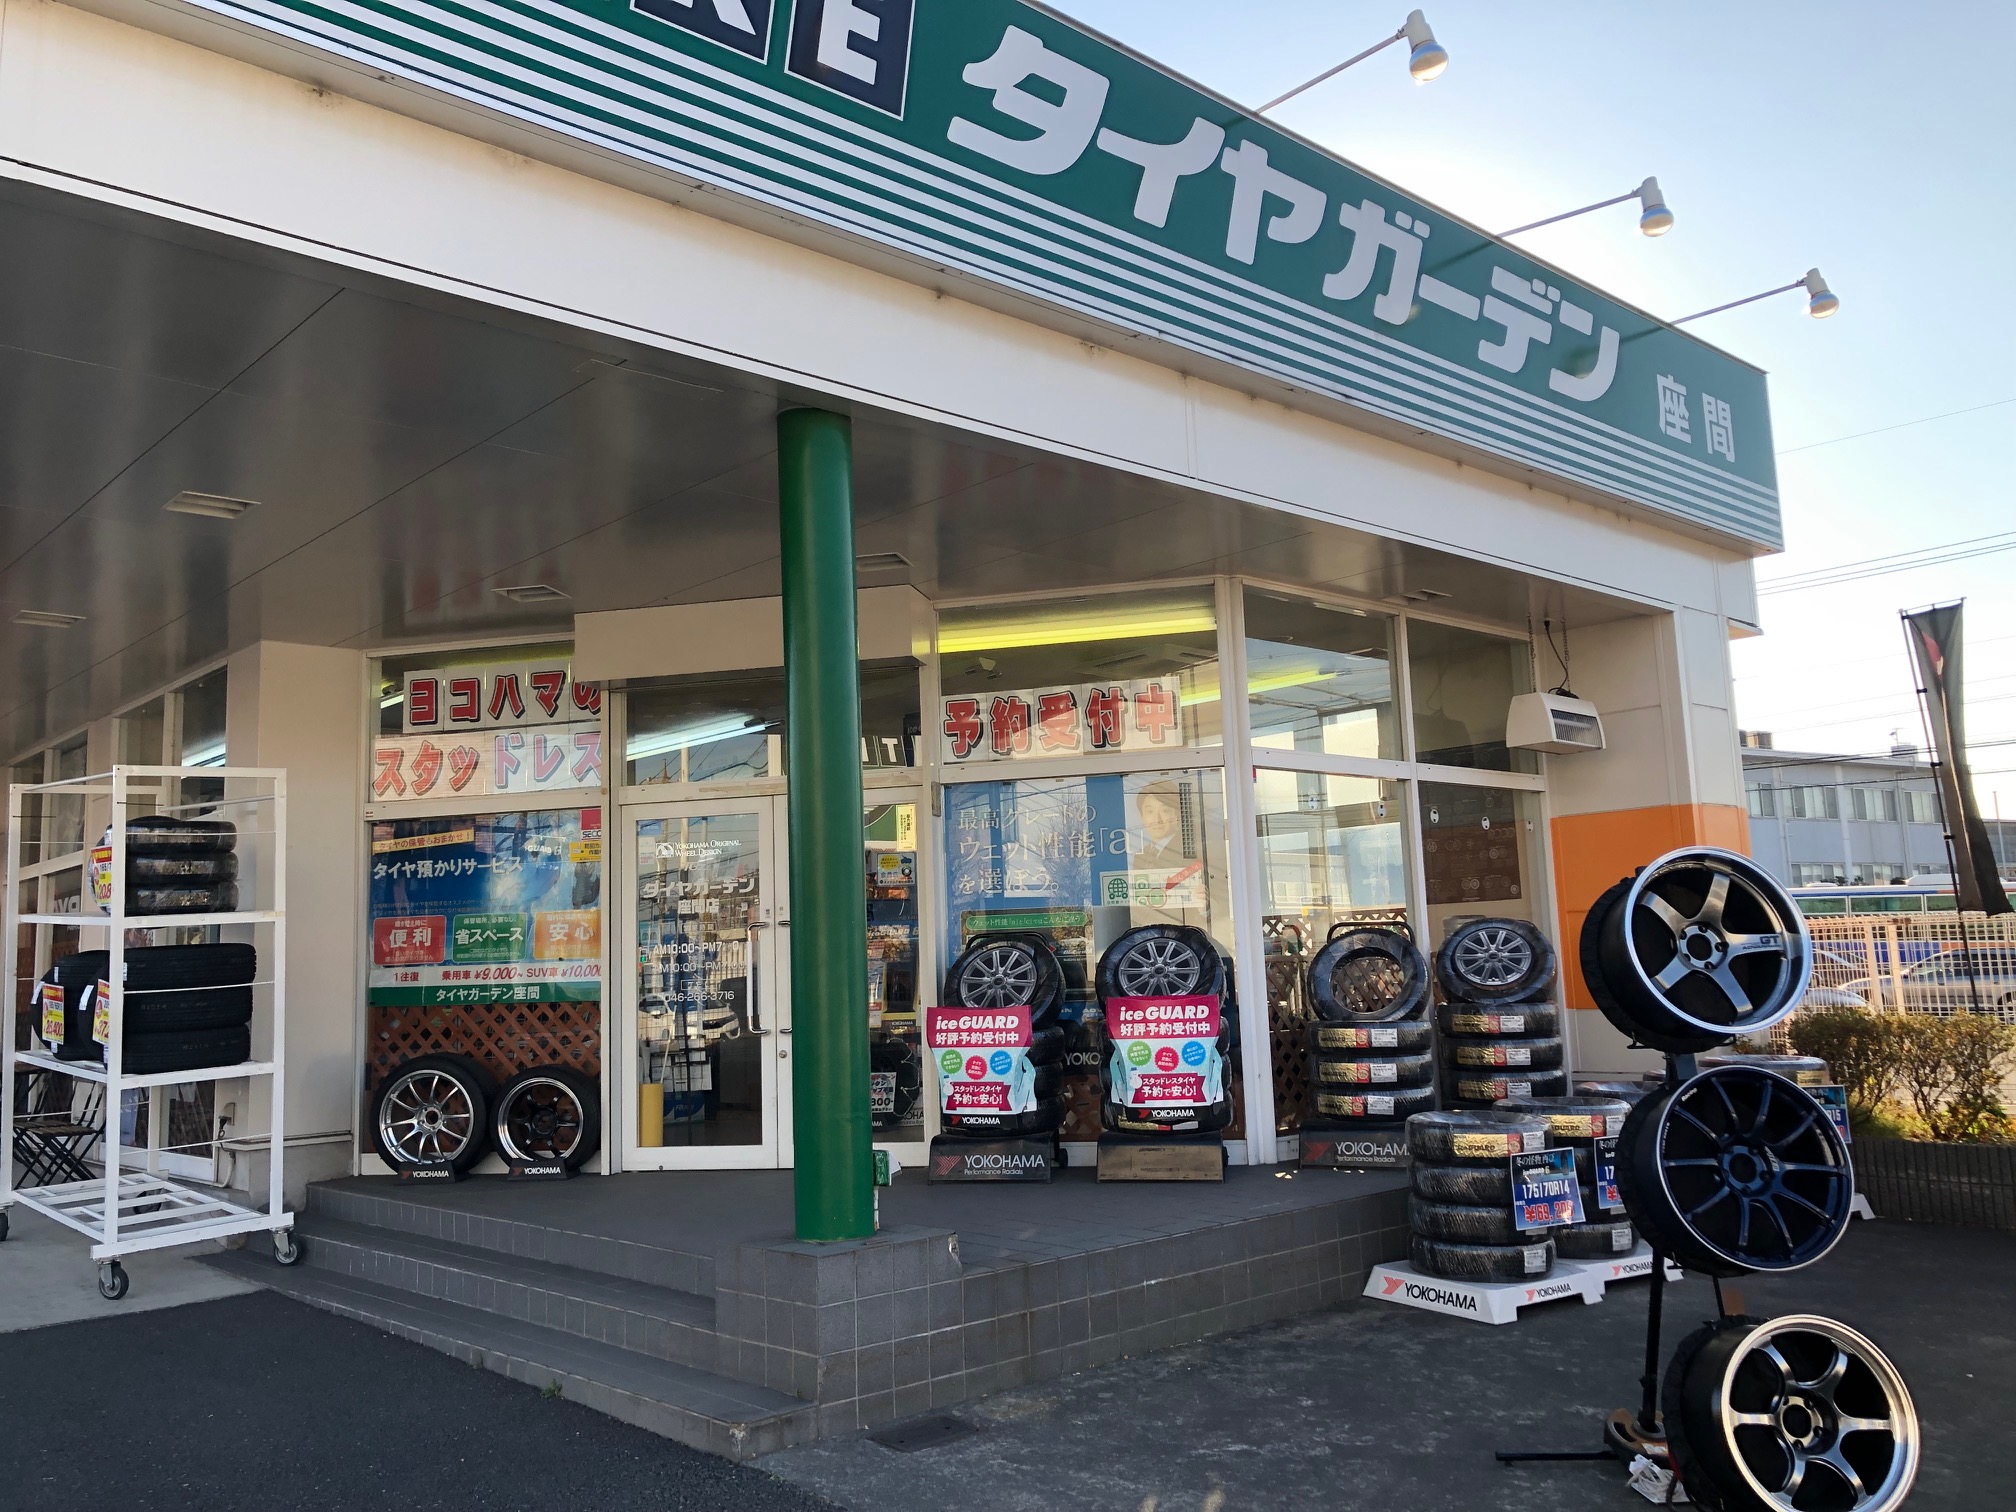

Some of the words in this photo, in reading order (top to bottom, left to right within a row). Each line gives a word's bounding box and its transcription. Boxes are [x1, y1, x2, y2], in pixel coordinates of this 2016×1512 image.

[947, 23, 1620, 402] タイヤガーデン
[1656, 373, 1736, 464] 座間
[409, 670, 601, 726] ヨコハマの
[943, 684, 1180, 759] 予約受付中
[372, 730, 601, 797] スタッドレス
[958, 803, 1098, 831] 最高グレードの
[675, 841, 709, 850] YOKOHAMA
[710, 838, 742, 847] ORIGINAL
[674, 849, 698, 857] WHEEL
[698, 848, 722, 857] DESIGN
[372, 856, 524, 880] タイヤ預かりサービス
[958, 867, 1060, 895] を選ぼう。
[389, 927, 432, 948] 便利
[455, 927, 524, 945] 省スペース
[548, 921, 594, 942] 安心
[1760, 935, 1779, 944] GT
[393, 971, 420, 983] 1往復
[441, 970, 472, 981] 乗用車
[436, 985, 540, 1002] タイヤガーデン座間
[663, 990, 735, 1002] 046-266-3716
[1119, 1005, 1210, 1021] iceGUARD
[935, 1015, 1020, 1030] iceGUARD
[1120, 1021, 1211, 1037] 好評予約受付中
[935, 1031, 1020, 1046] 好評予約受付中
[953, 1085, 1002, 1093] スタッドレスタイヤ
[1142, 1077, 1196, 1085] スタッドレスタイヤ
[961, 1116, 1001, 1125] YOKOHAMA
[1151, 1109, 1195, 1118] YOKOHAMA
[1335, 1141, 1410, 1157] YOKOHAM
[964, 1154, 1046, 1169] YOKOHAMA
[412, 1170, 449, 1178] YOKOHAMA
[524, 1166, 561, 1175] YOKOHAMA
[964, 1168, 1001, 1176] Performance
[1002, 1168, 1024, 1176] Radials
[1405, 1282, 1477, 1312] YOKOHAMA
[1536, 1282, 1572, 1298] YOKOHAMA
